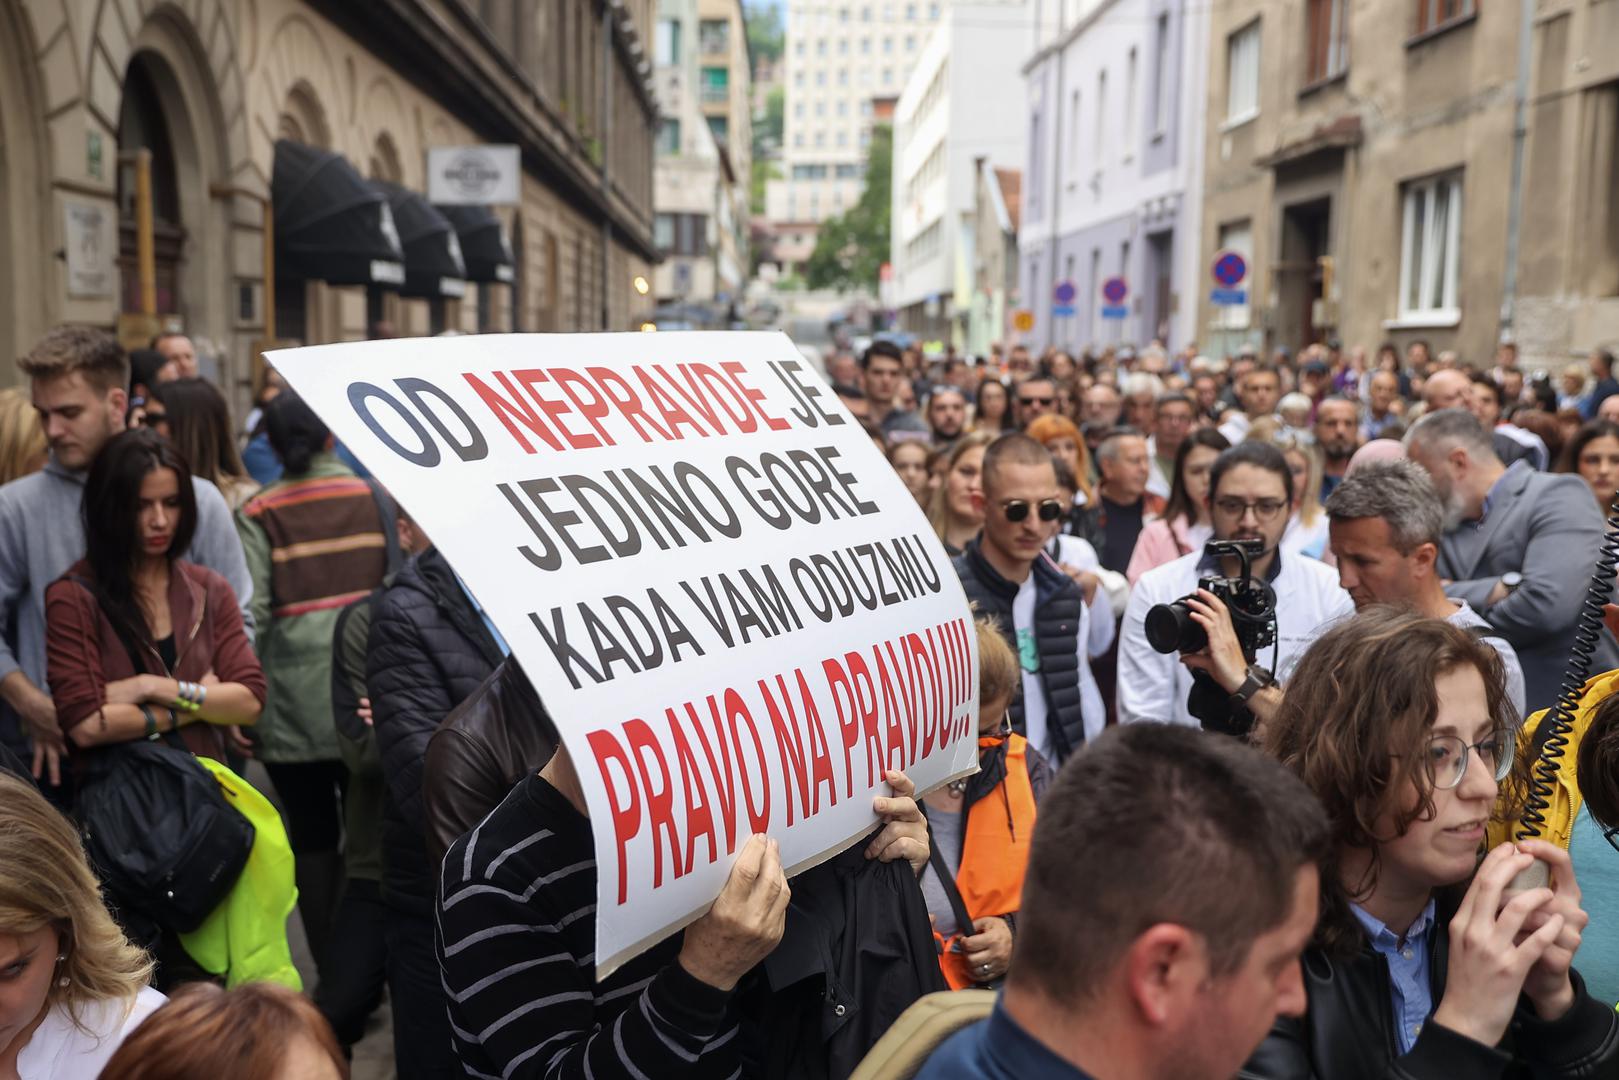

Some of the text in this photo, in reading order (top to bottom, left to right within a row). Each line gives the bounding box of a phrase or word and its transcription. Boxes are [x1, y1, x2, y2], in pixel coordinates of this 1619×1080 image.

[346, 361, 847, 468] OD NEPRAVDE JE
[496, 446, 881, 572] JEDINO GORE
[527, 534, 941, 690] KADA VAM ODUZMU
[585, 617, 972, 907] PRAVO NA PRAVDU!!!
